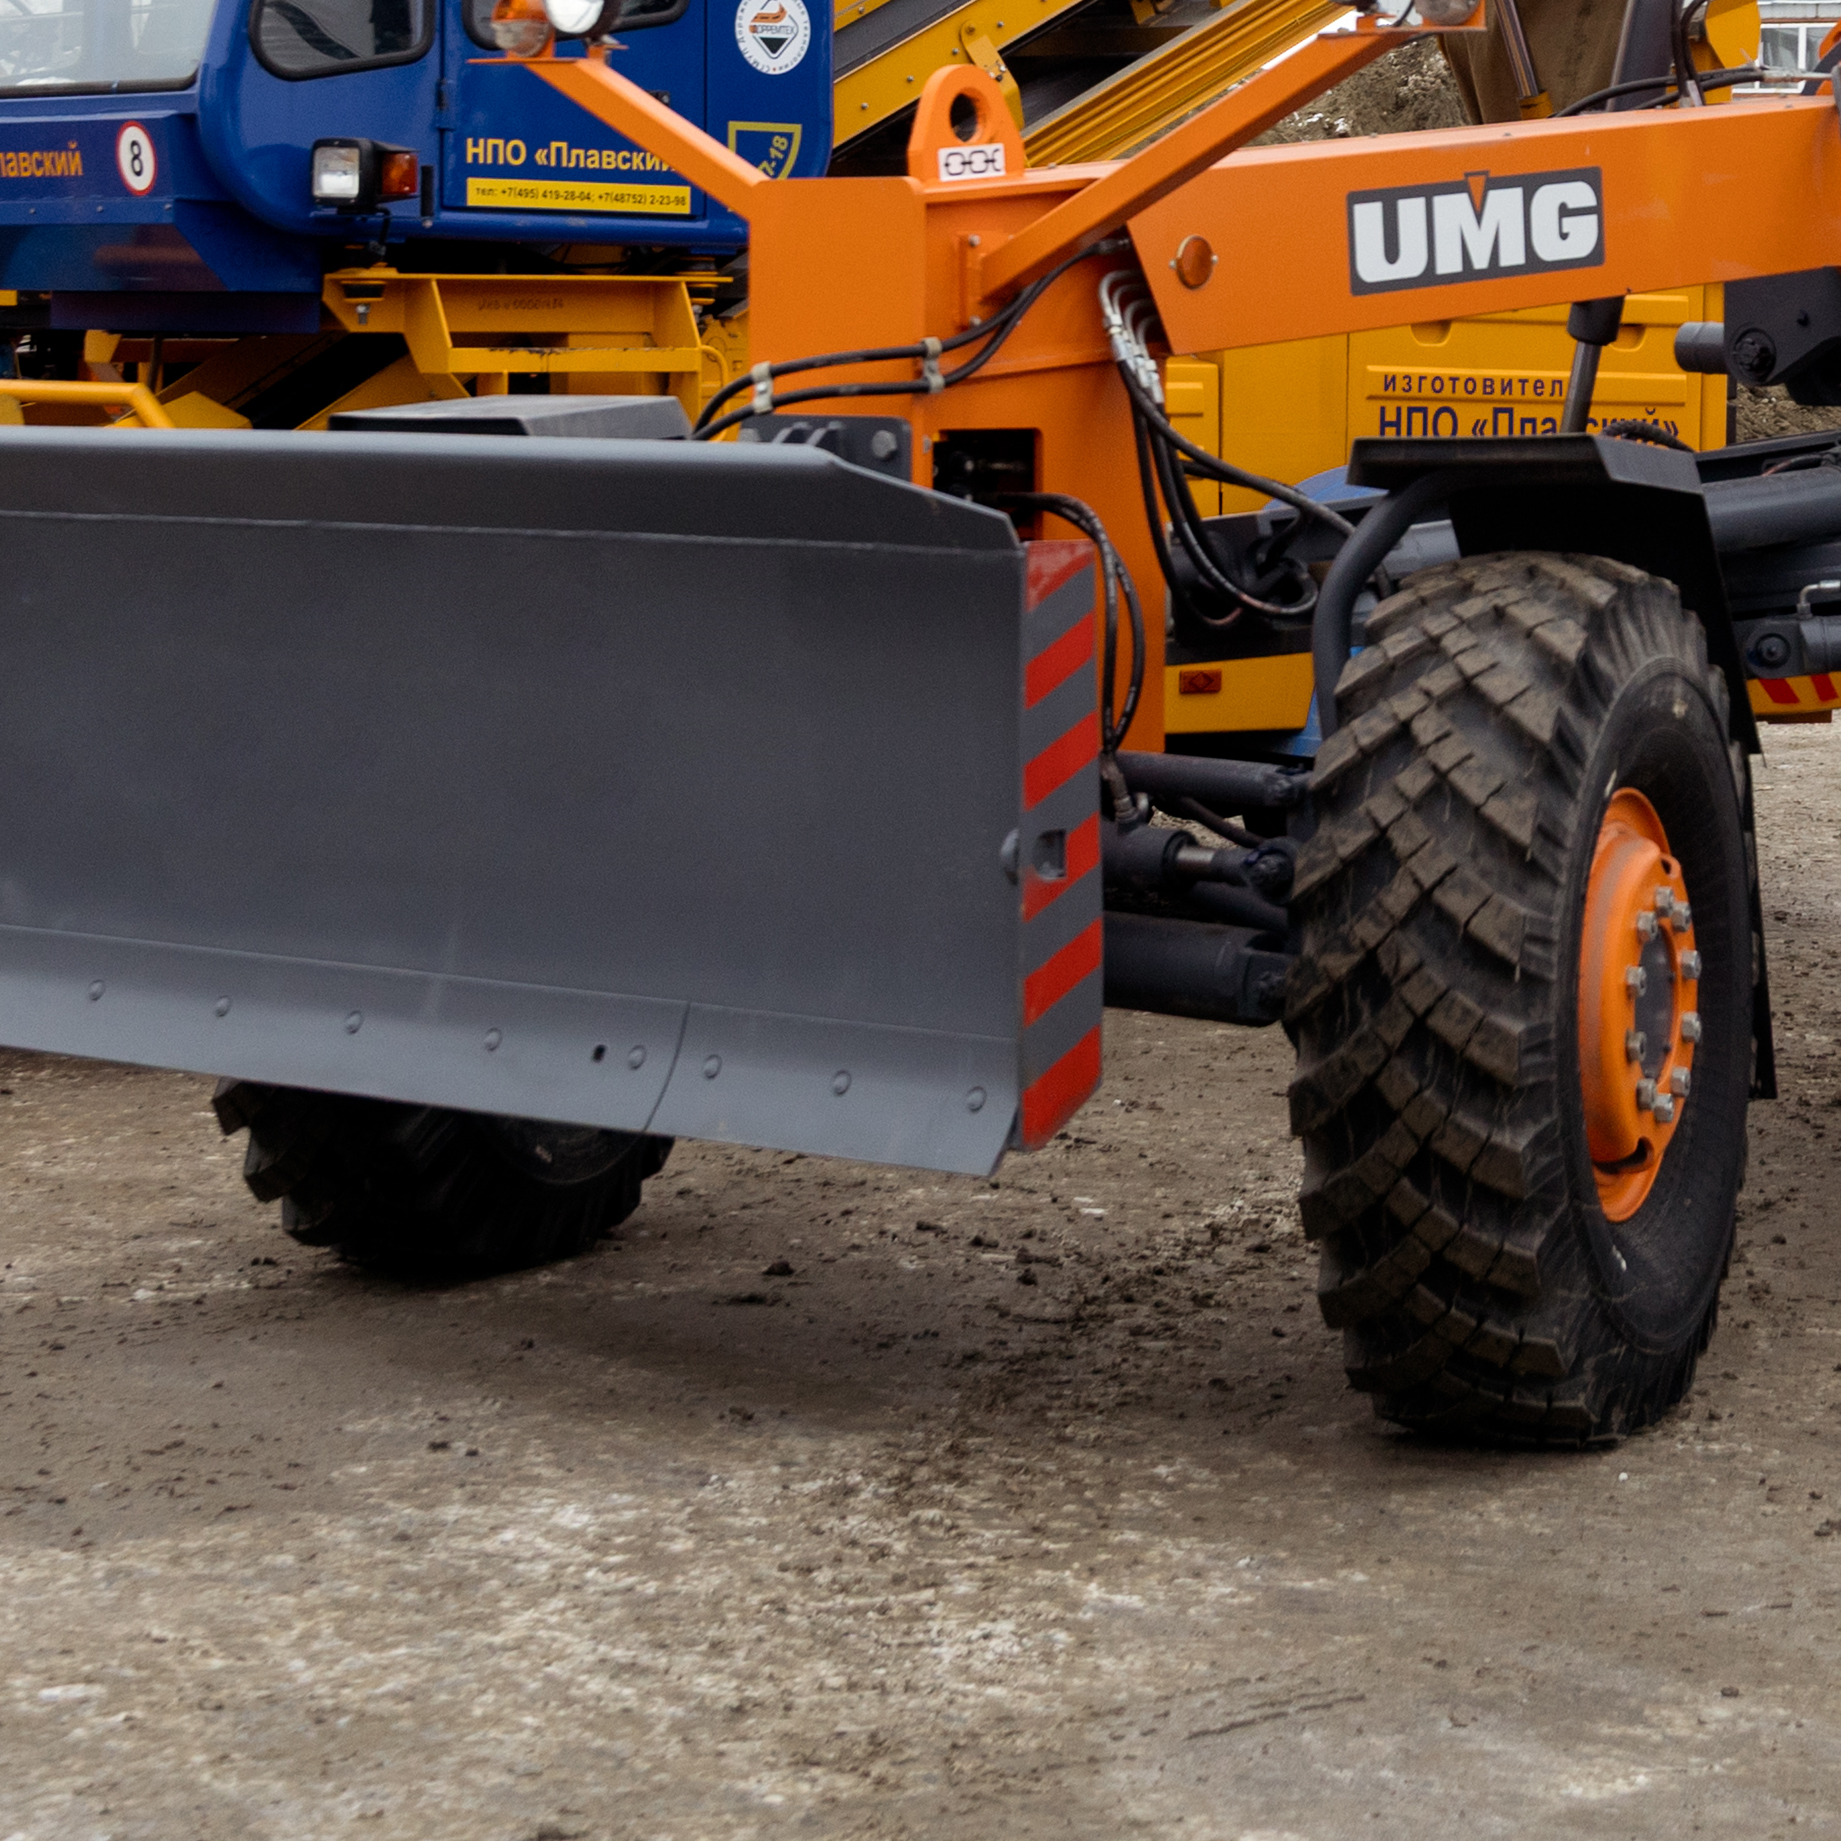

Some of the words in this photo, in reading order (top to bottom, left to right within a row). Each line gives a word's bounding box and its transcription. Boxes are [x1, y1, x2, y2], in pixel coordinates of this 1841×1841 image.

[130, 140, 144, 177] 8
[466, 137, 527, 166] НПО
[501, 187, 540, 200] +7(495)
[598, 192, 647, 205] +7(48752)
[650, 194, 687, 207] 2-23-98
[1353, 181, 1599, 283] UMG
[1384, 374, 1564, 397] изготовител
[1379, 406, 1458, 438] НПО
